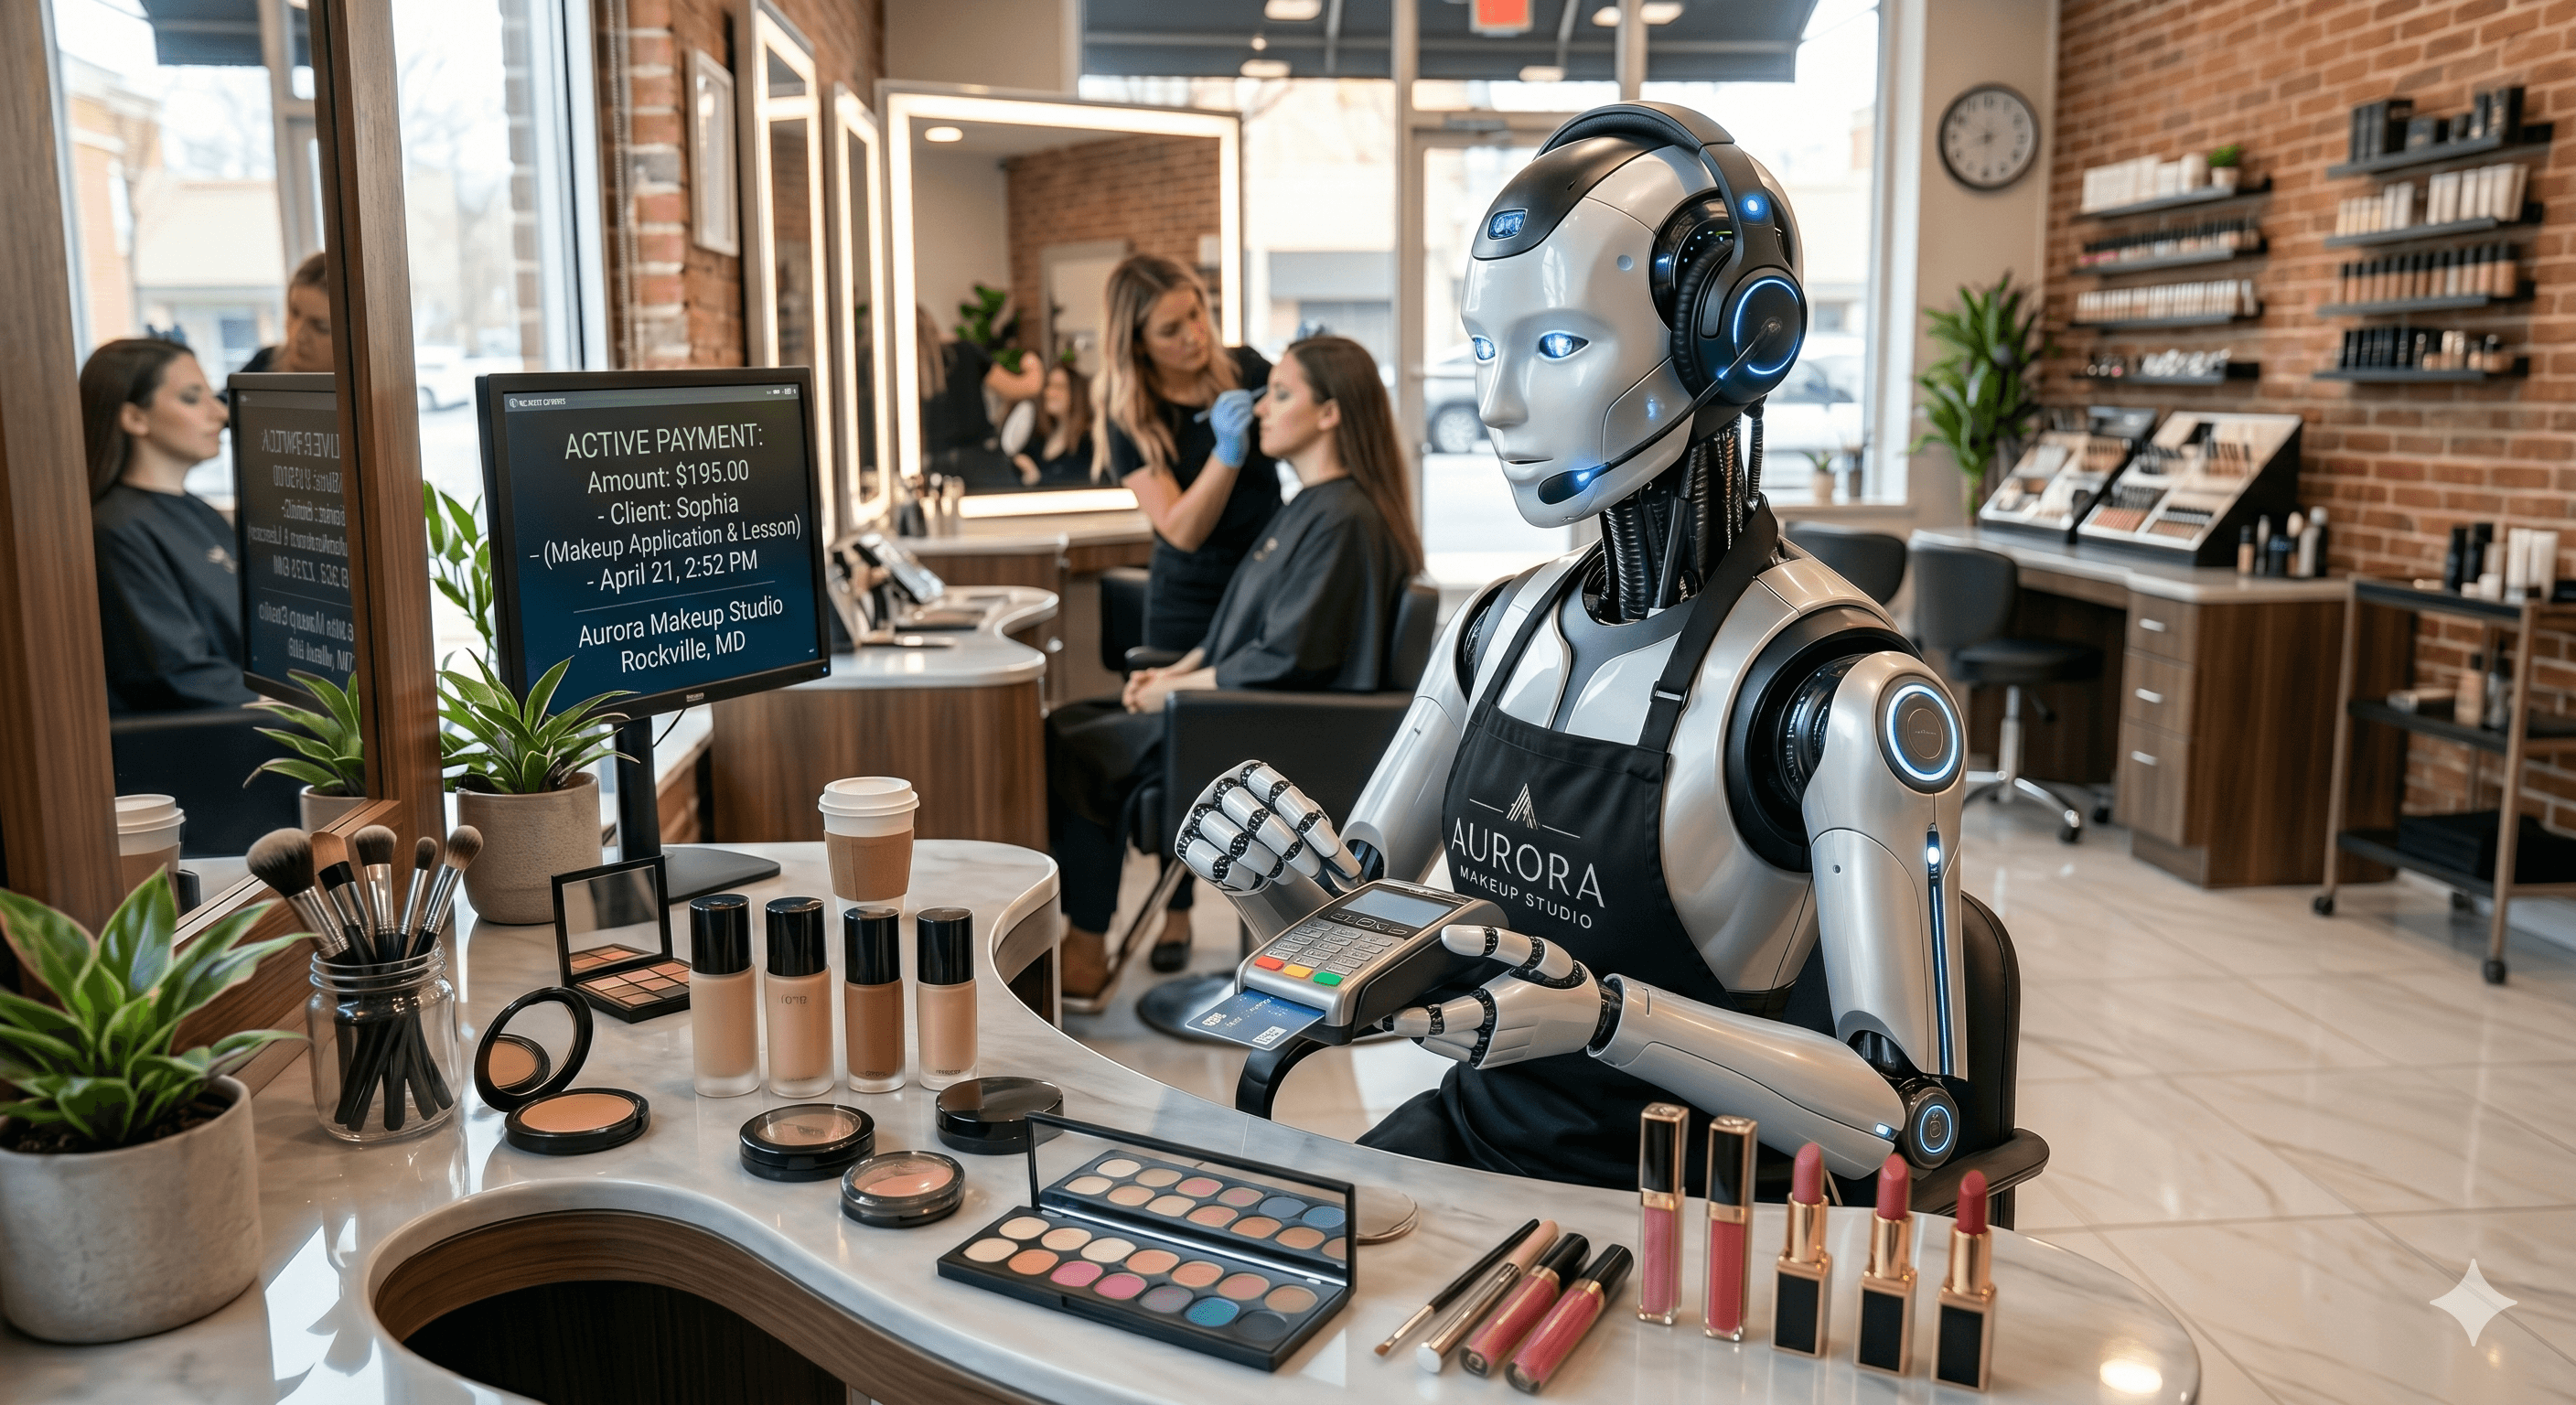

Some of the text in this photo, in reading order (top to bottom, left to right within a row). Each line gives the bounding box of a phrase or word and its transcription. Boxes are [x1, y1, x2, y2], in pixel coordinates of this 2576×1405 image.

[564, 423, 763, 460] ACTIVE PAYMENT:
[587, 459, 749, 494] Amount: $195.00
[610, 499, 671, 525] Client:
[676, 492, 739, 522] Sophia
[544, 538, 624, 571] (Makeup
[628, 525, 723, 558] Application
[726, 521, 738, 542] &
[742, 513, 801, 541] Lesson)
[599, 562, 646, 595] April
[650, 560, 680, 585] 21,
[684, 553, 725, 579] 2:52
[729, 549, 757, 573] PM
[578, 595, 783, 649] Aurora Makeup Studio
[621, 630, 746, 673] Rockville, MD
[1451, 817, 1605, 908] AURORA
[1460, 864, 1519, 899] MAKEUP
[1525, 893, 1593, 929] STUDIO
